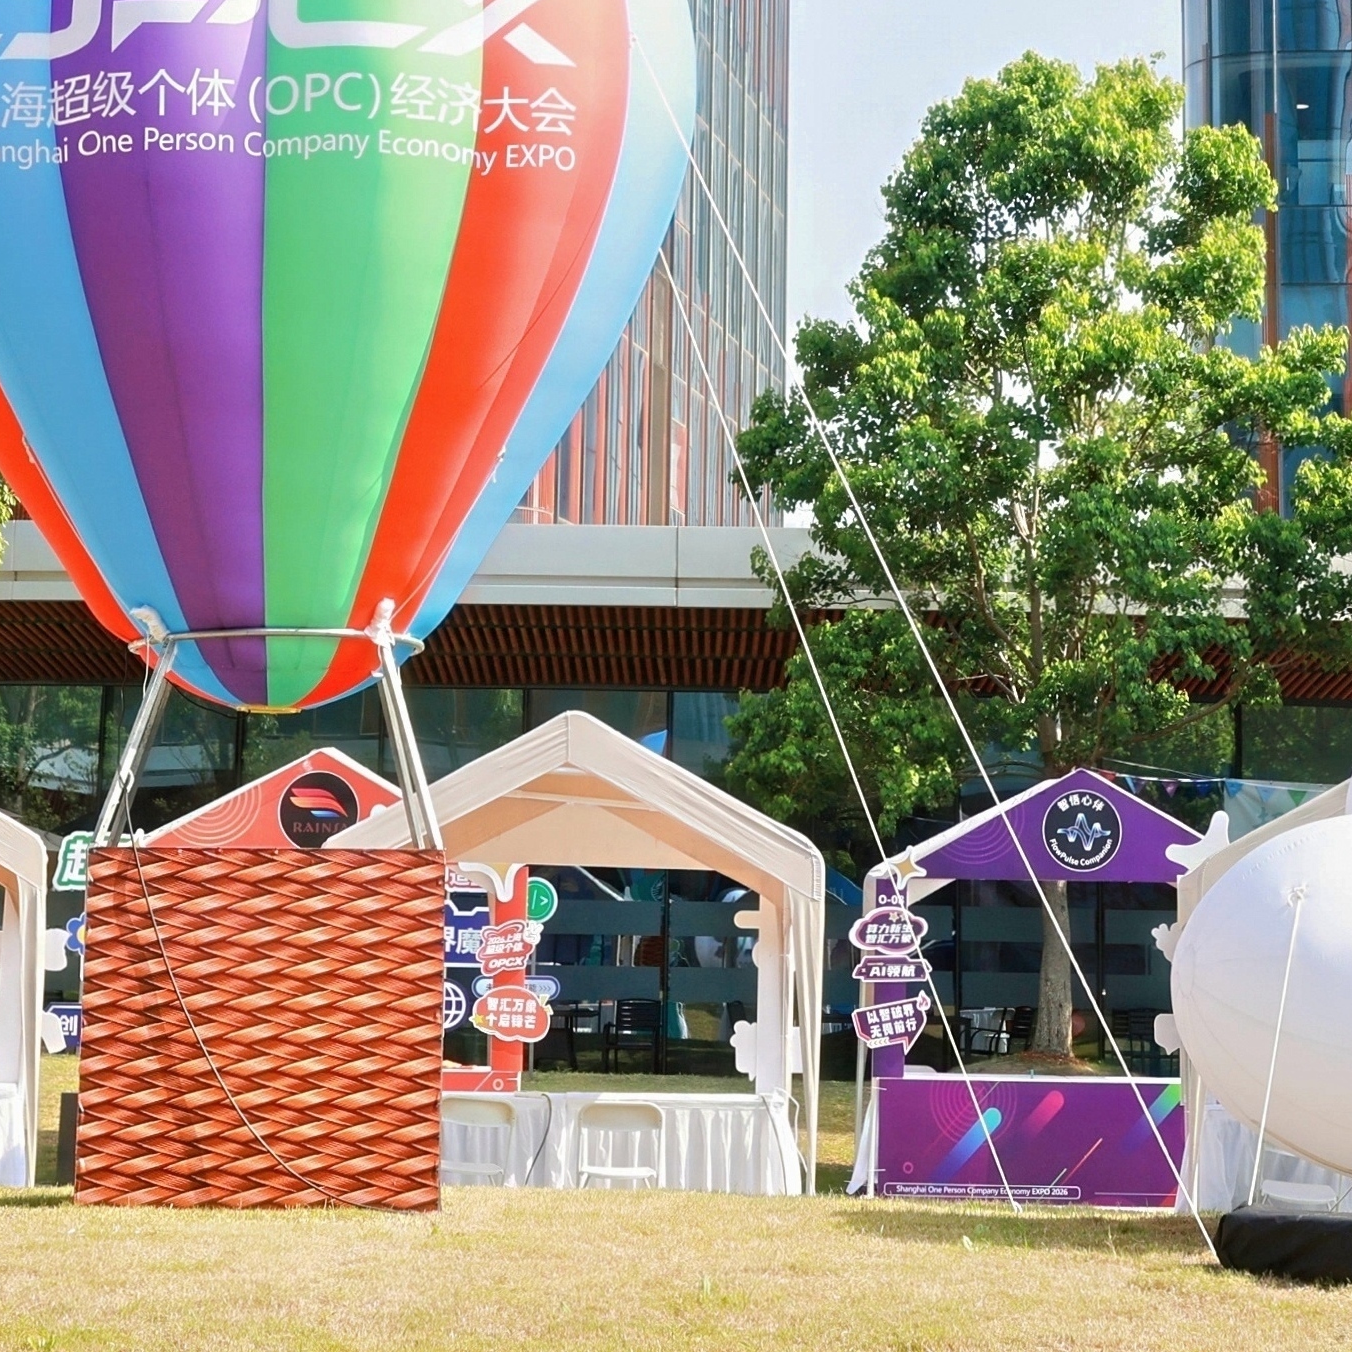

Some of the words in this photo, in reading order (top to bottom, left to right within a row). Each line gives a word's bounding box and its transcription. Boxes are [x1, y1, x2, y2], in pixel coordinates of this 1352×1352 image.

[78, 130, 133, 156] One
[144, 127, 234, 156] Person
[244, 132, 369, 160] Company
[378, 130, 497, 176] Economy
[506, 144, 576, 171] EXPO
[1049, 838, 1079, 866] FlowPulse
[1080, 838, 1113, 866] Companion
[489, 956, 524, 968] OPCX
[487, 997, 536, 1013] 智汇万象
[896, 1185, 927, 1195] Shanghai
[928, 1186, 942, 1194] One
[943, 1186, 967, 1194] Person
[967, 1187, 999, 1196] Company
